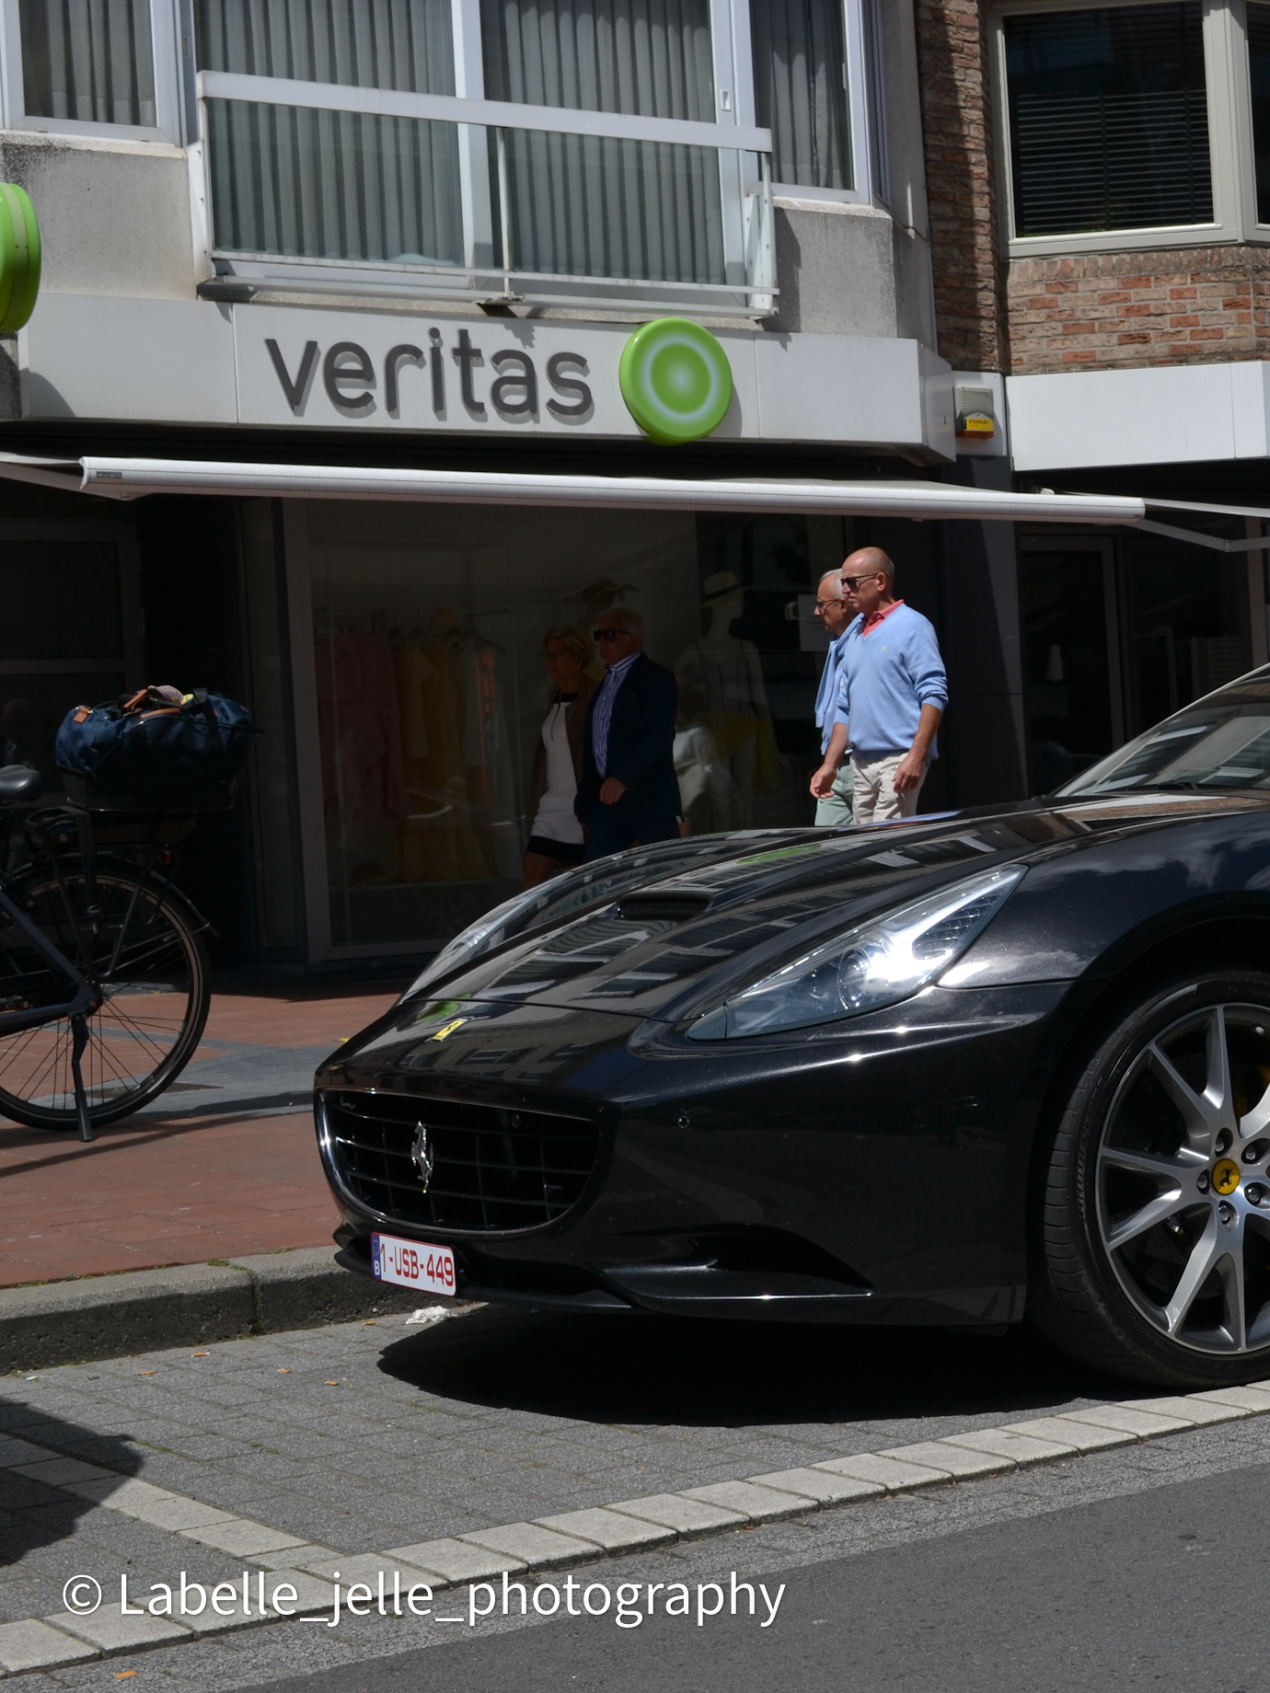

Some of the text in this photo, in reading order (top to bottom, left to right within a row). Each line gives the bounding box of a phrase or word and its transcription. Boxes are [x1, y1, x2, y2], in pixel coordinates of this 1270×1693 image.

[264, 327, 592, 417] veritas
[374, 1243, 454, 1287] B 1-USB-449
